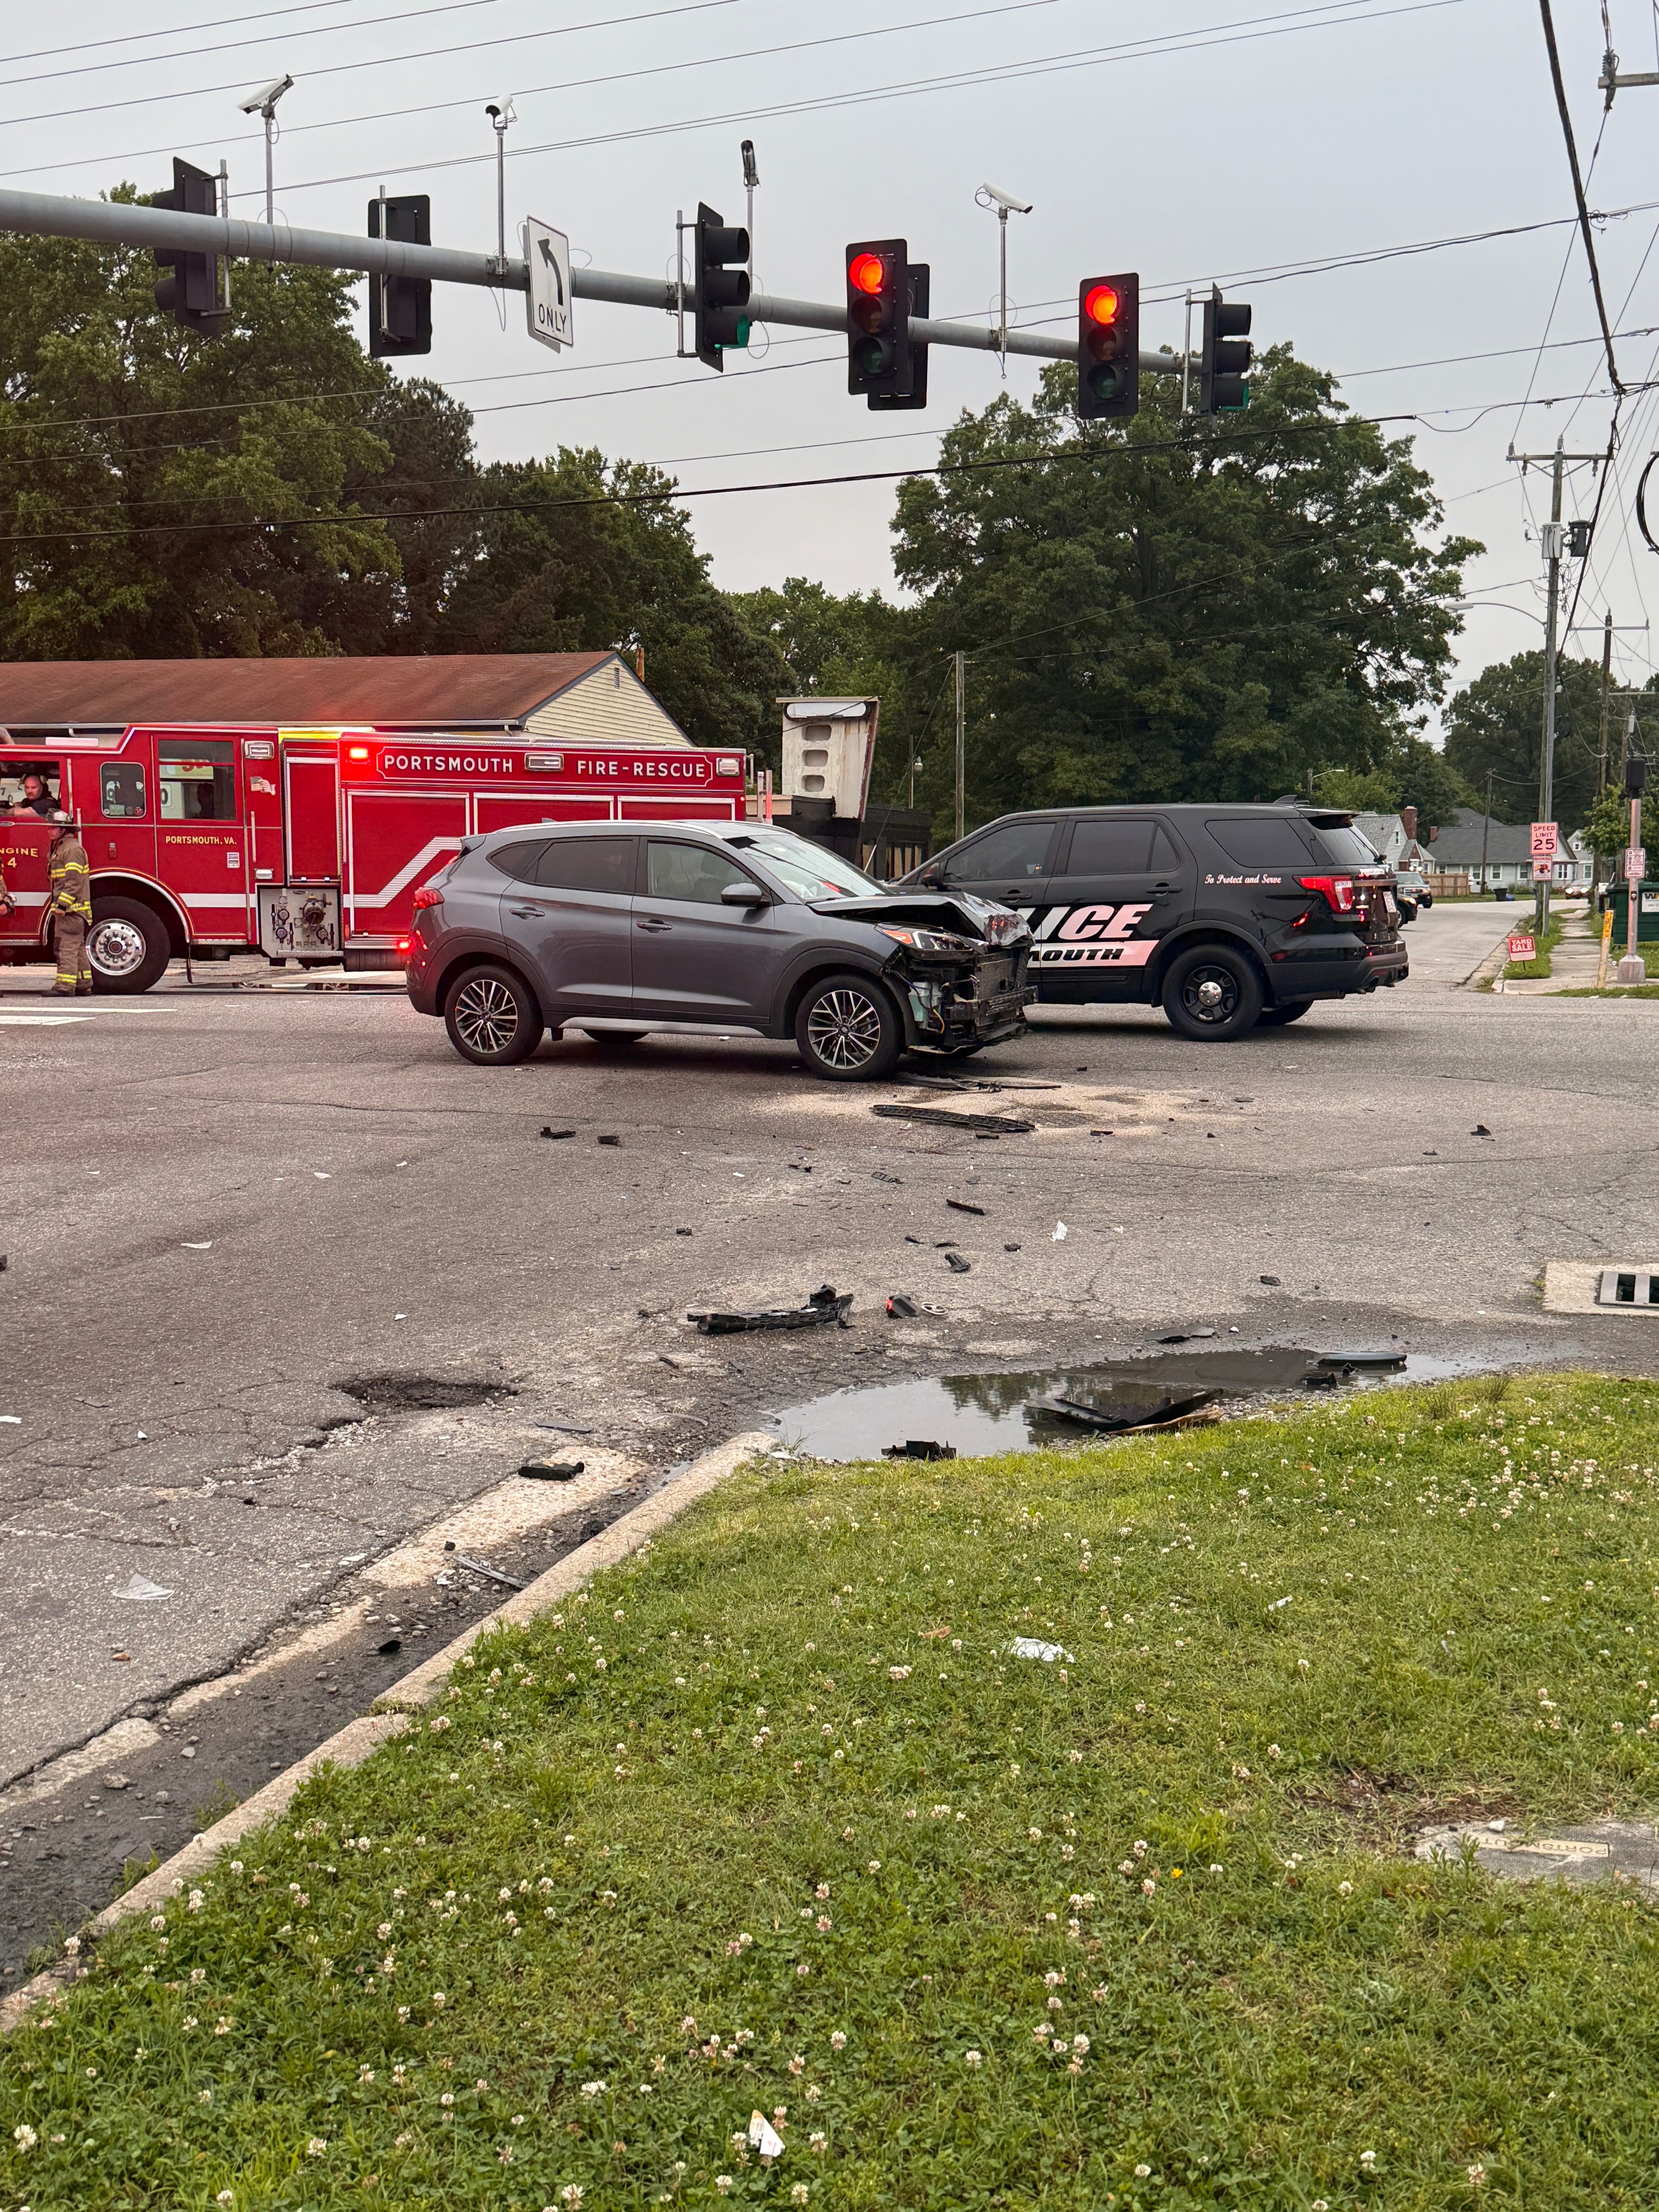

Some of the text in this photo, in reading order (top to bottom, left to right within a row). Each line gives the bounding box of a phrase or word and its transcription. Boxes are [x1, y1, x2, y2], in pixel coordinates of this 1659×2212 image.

[538, 303, 567, 334] ONLY
[384, 754, 705, 778] PORTSMOUTH FIRE-RESCUE
[224, 836, 237, 845] VA.
[1534, 838, 1554, 850] 25
[7, 857, 17, 868] 4
[1204, 874, 1281, 884] To Protect and Serve
[1511, 943, 1533, 952] SALE
[1474, 1837, 1606, 1854] PORTSMUT
